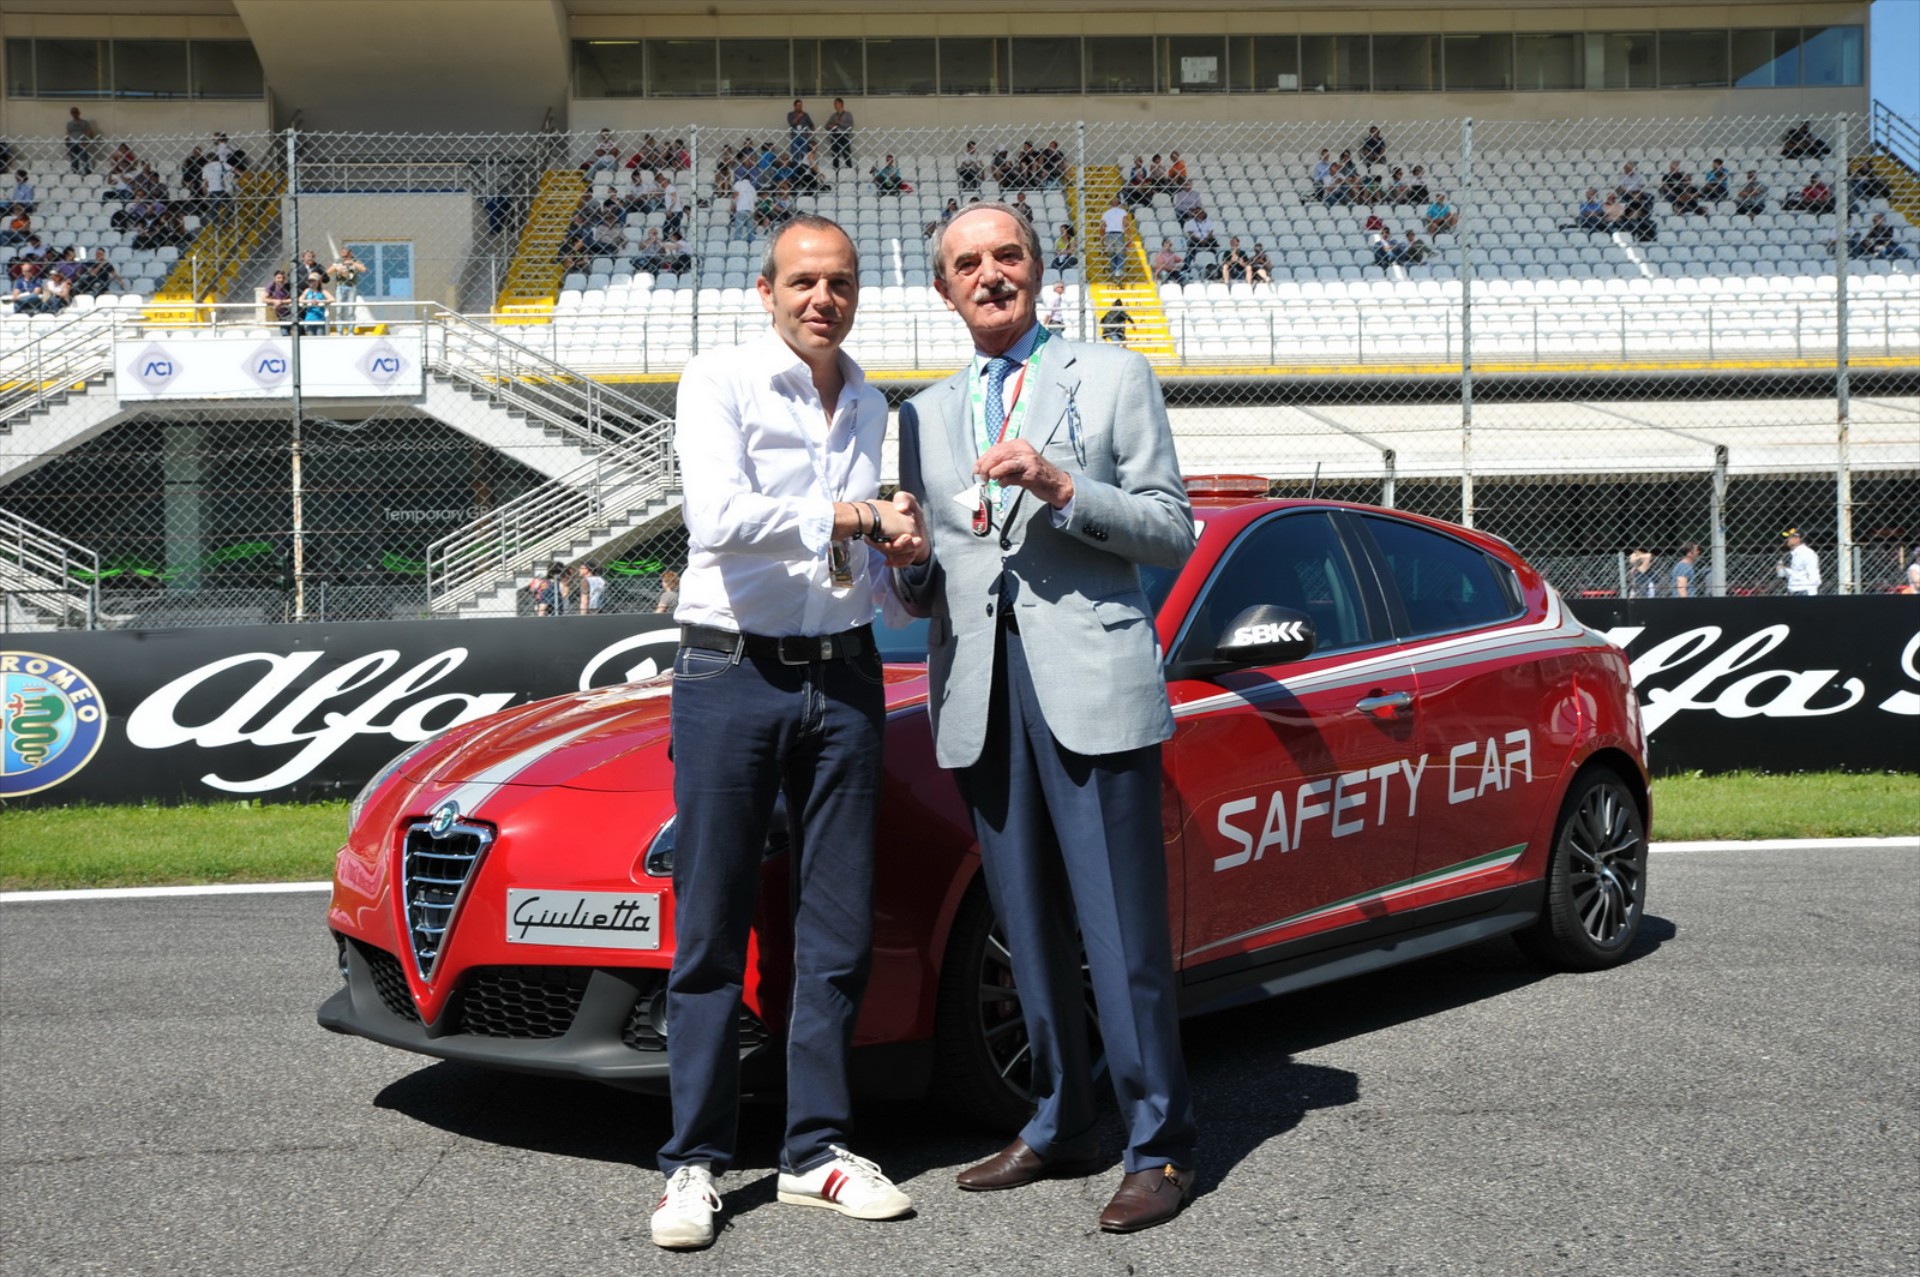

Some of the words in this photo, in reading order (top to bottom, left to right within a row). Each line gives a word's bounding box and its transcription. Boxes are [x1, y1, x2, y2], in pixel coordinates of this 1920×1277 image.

[144, 362, 172, 376] ACI
[258, 359, 286, 374] ACI
[371, 358, 399, 372] ACI
[384, 508, 465, 523] Temporary
[0, 656, 99, 723] ROMEO
[1594, 624, 1865, 737] lfa
[126, 647, 516, 793] Alfa
[1213, 753, 1429, 872] SAFETY
[1448, 728, 1532, 805] CAR
[513, 896, 651, 939] Giulietta
